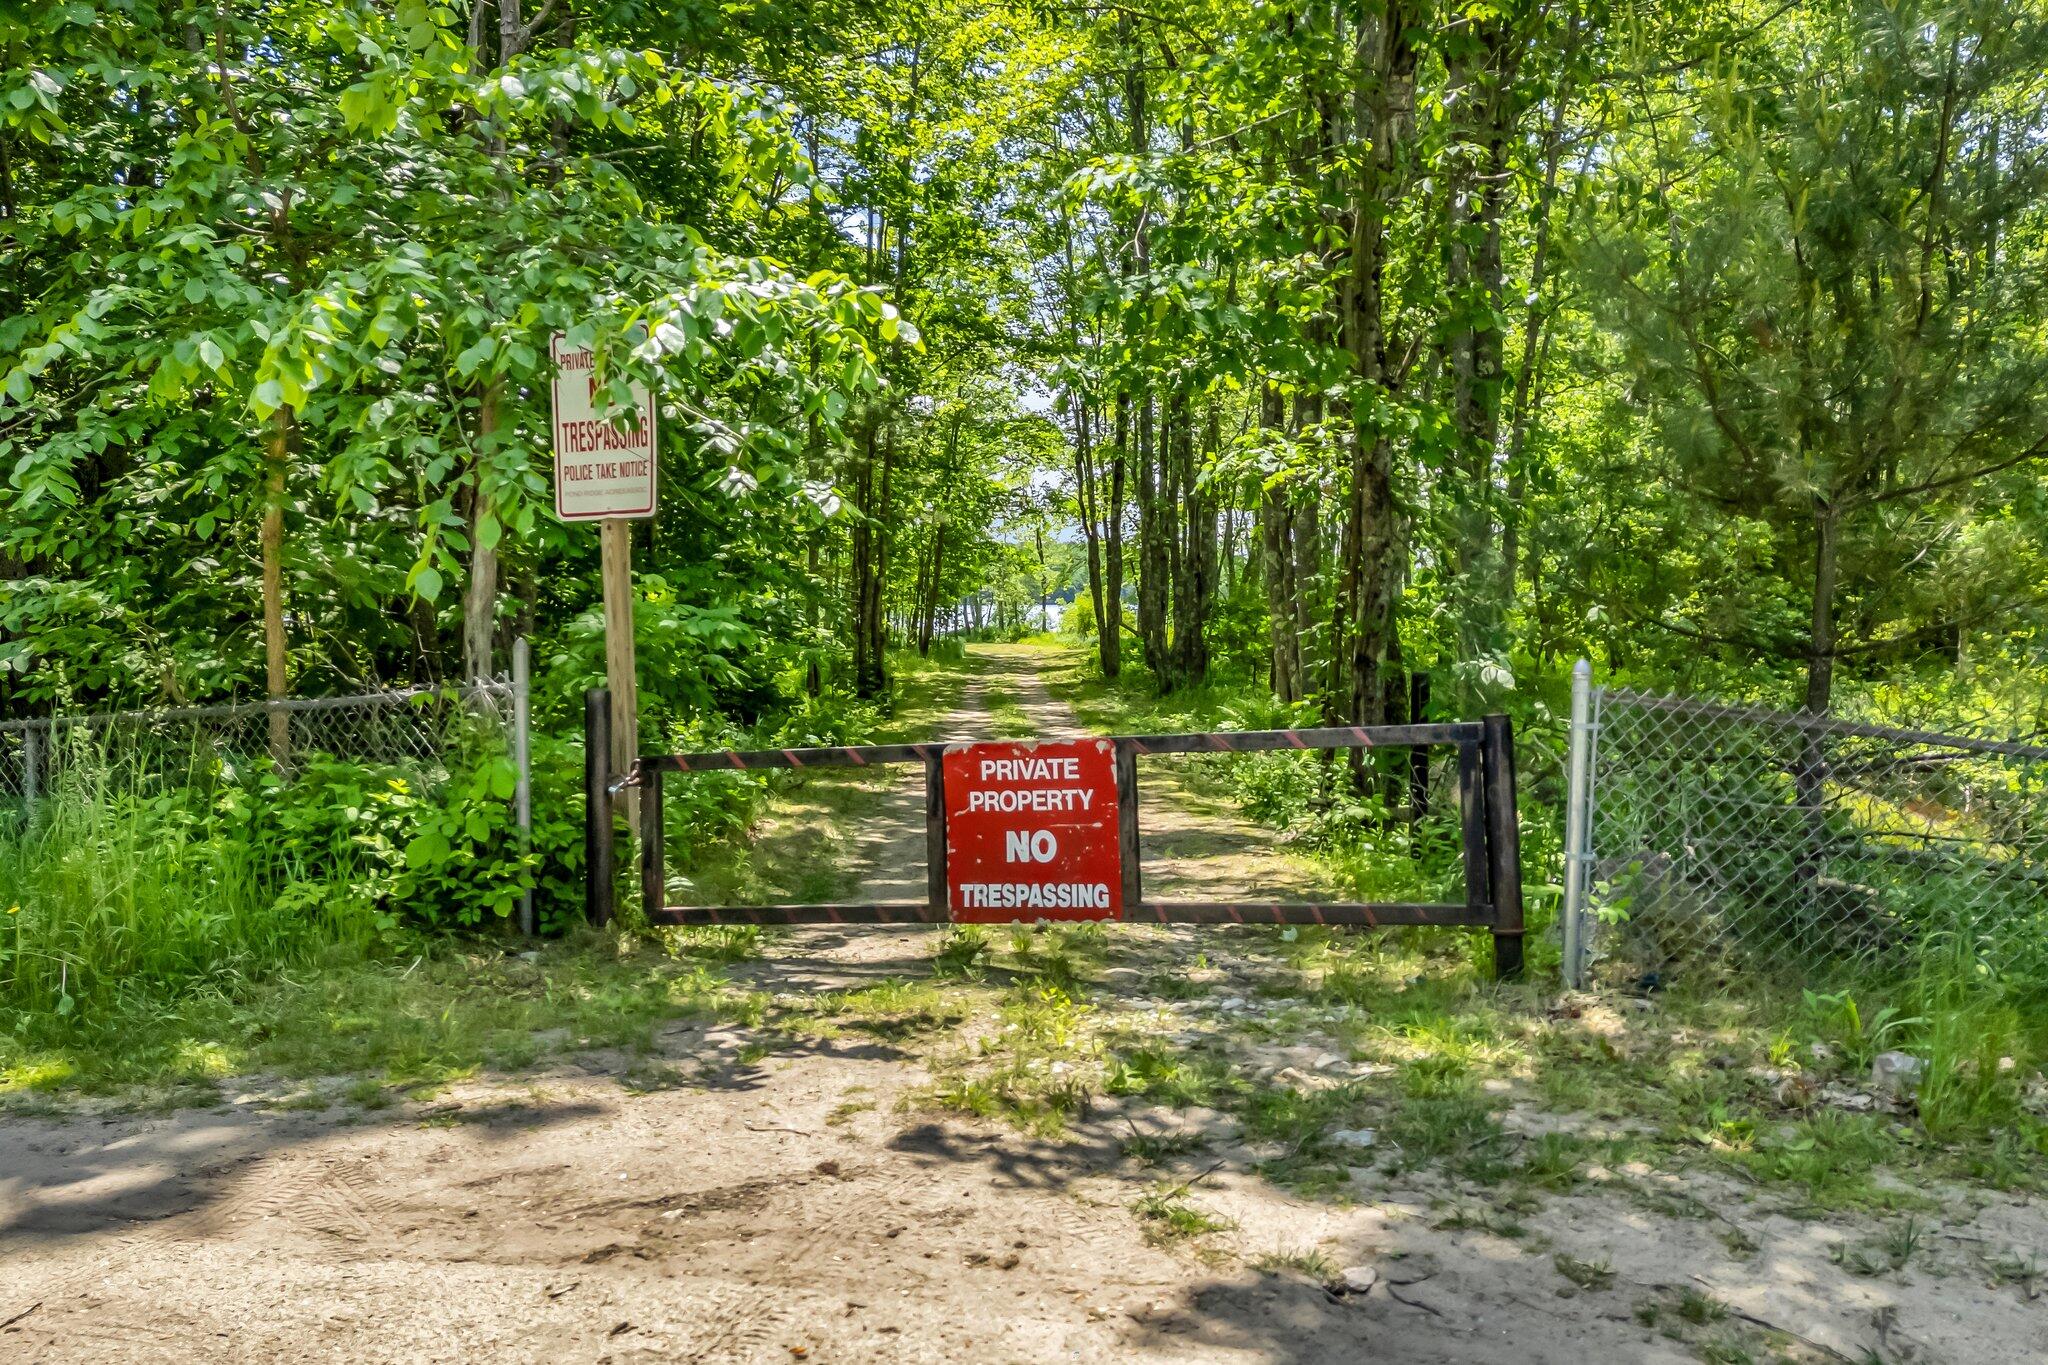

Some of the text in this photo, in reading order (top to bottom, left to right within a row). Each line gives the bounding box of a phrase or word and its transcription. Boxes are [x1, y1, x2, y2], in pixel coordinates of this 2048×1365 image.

[560, 351, 594, 371] PRIVATE
[564, 460, 648, 481] POLICE TAKE NOTICE
[981, 757, 1081, 781] PRIVATE
[969, 788, 1094, 813] PROPERTY
[1005, 829, 1058, 863] NO
[960, 882, 1110, 908] TRESPASSING
